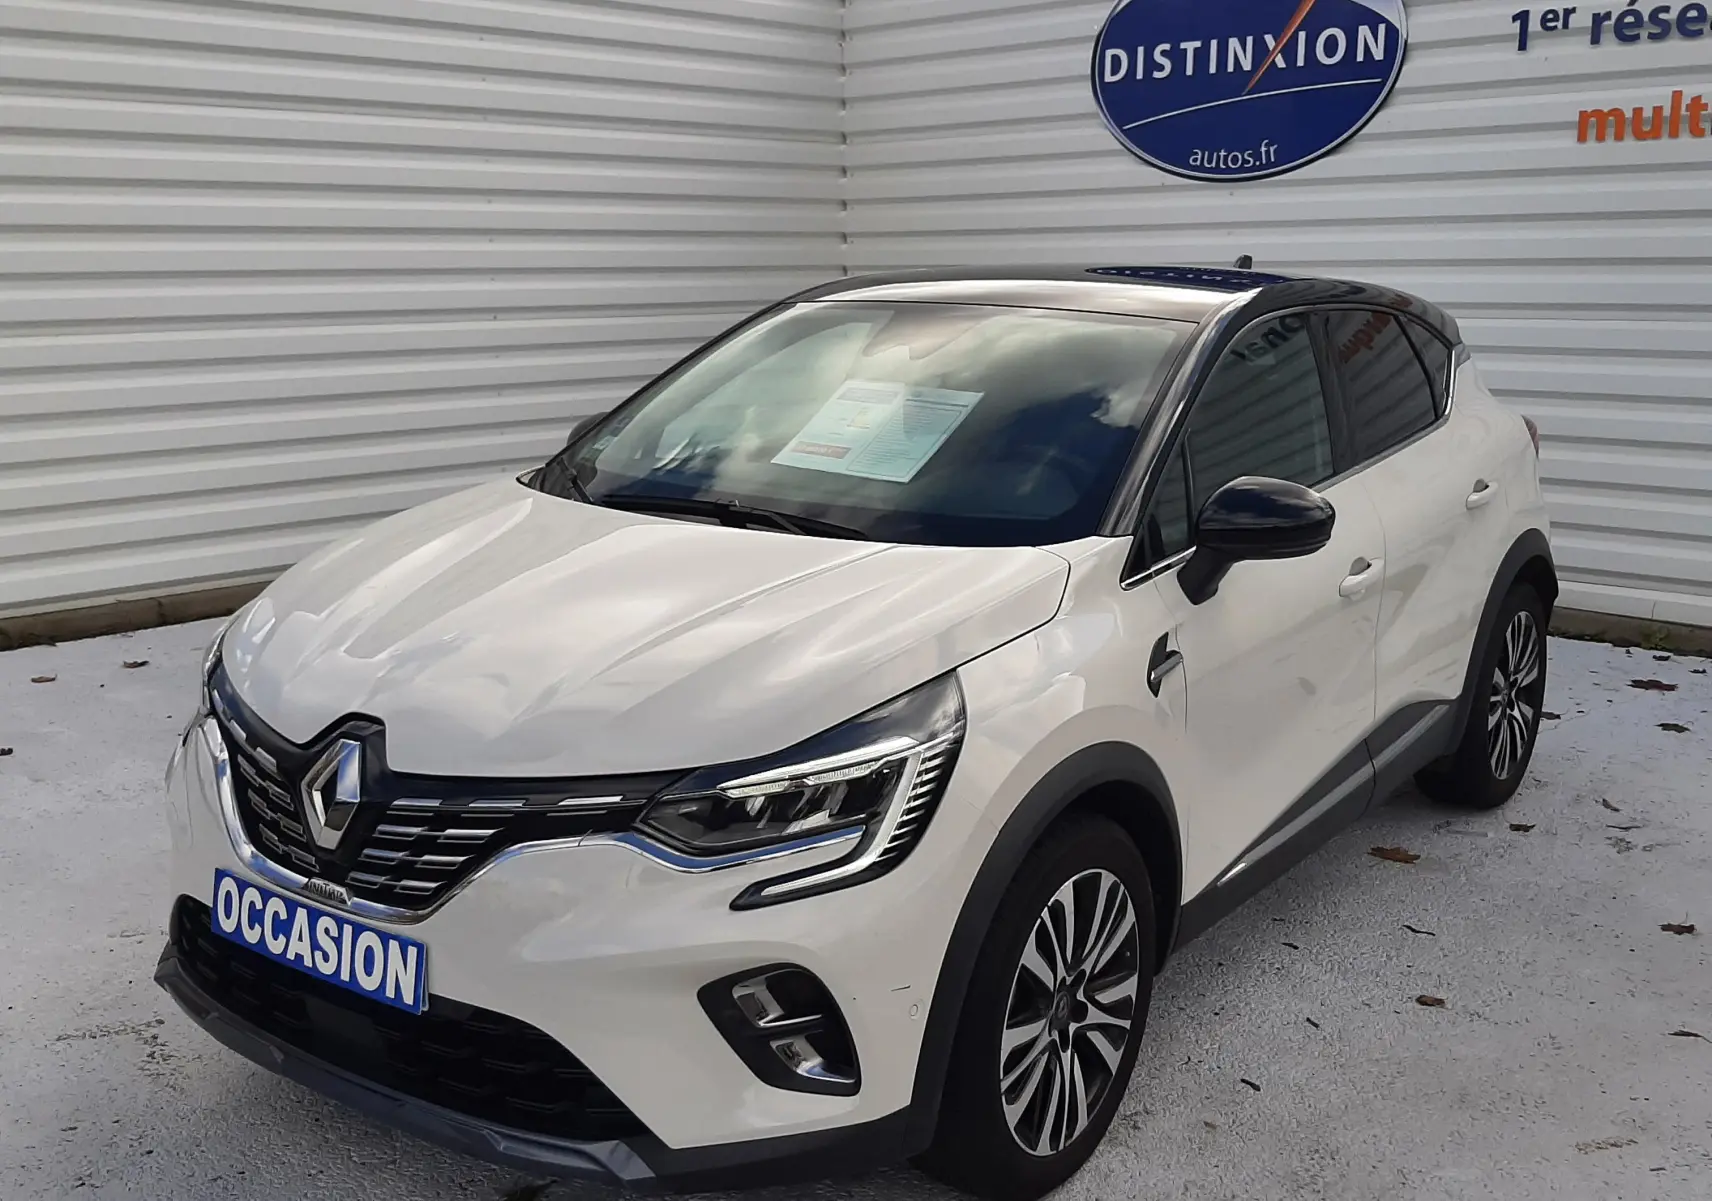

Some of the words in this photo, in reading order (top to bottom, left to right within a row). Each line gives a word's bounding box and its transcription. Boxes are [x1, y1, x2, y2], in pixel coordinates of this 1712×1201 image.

[1512, 6, 1576, 51] 1er
[1590, 0, 1712, 45] rése
[1103, 23, 1386, 82] DISTINXION
[1577, 90, 1712, 143] mult
[1189, 140, 1278, 169] autos.fr
[217, 876, 418, 1006] OCCASION
